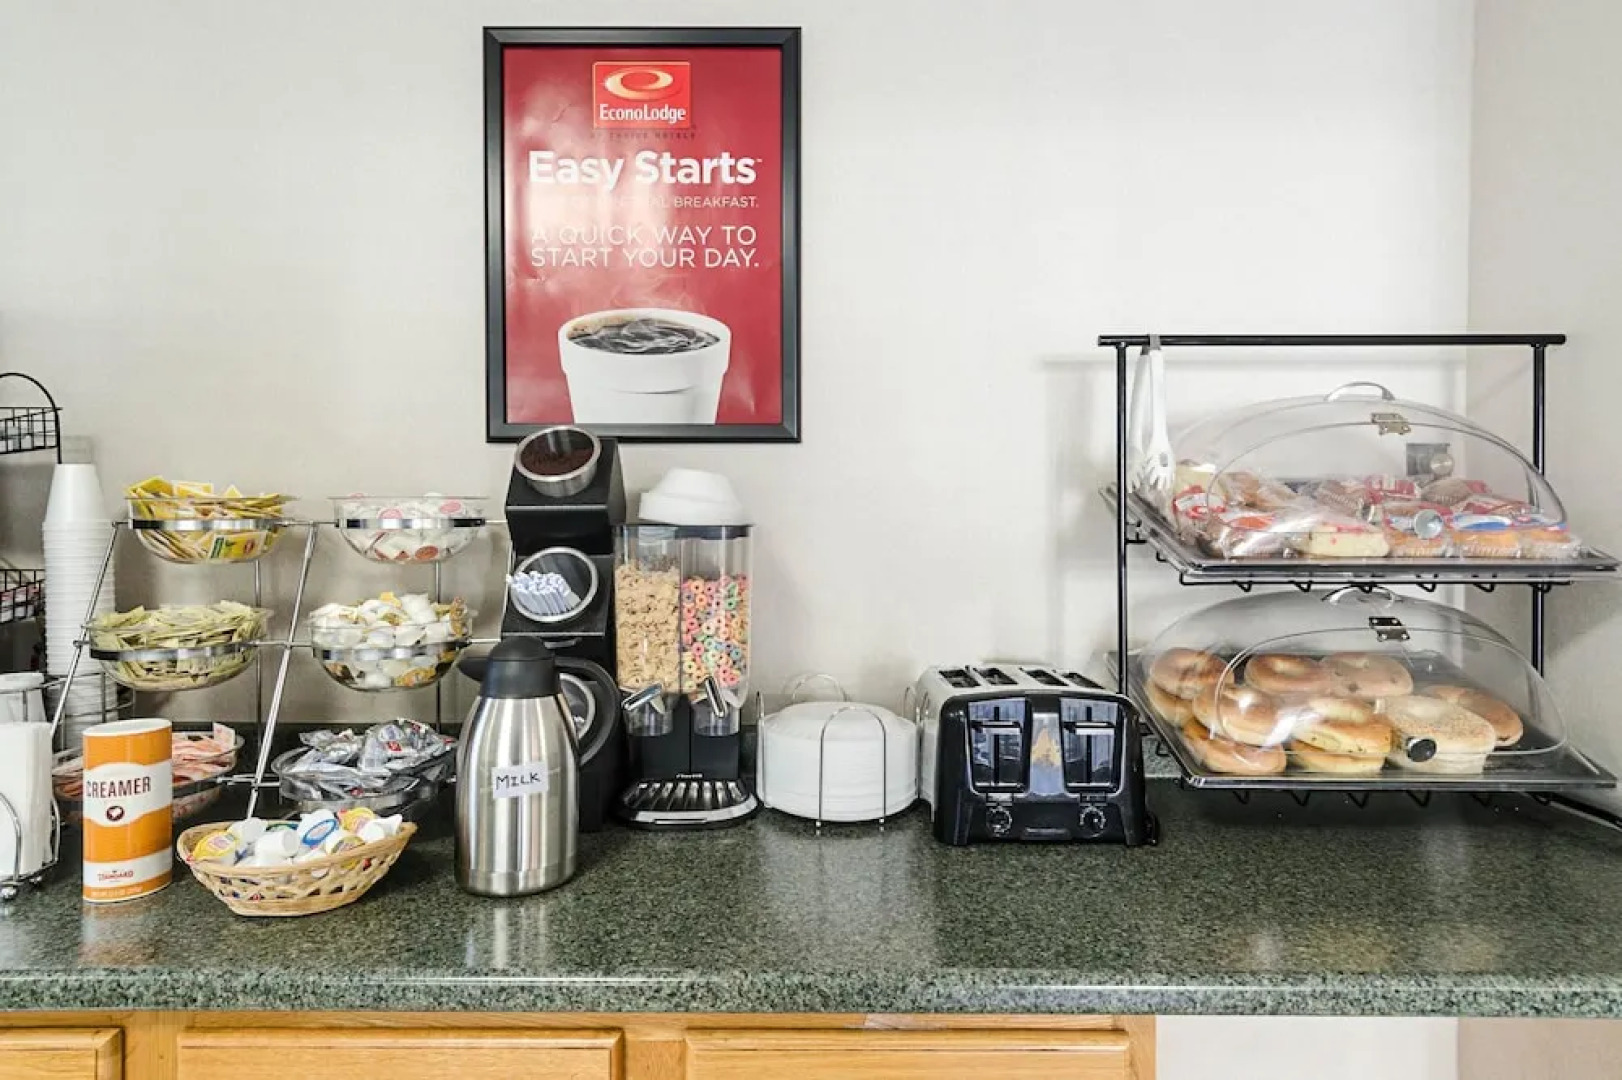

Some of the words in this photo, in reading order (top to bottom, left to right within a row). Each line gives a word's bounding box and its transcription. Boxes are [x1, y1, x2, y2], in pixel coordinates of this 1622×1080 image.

[599, 103, 687, 125] EconoLodge
[528, 150, 624, 191] Easy
[674, 195, 760, 208] BREAKFAST.
[531, 226, 547, 244] A
[559, 226, 644, 246] QUICK
[653, 226, 712, 245] WAY
[721, 226, 757, 245] TO
[531, 247, 614, 267] START
[622, 247, 695, 267] YOUR
[704, 248, 760, 267] DAY.
[86, 776, 151, 799] CREAMER
[495, 771, 542, 790] MILK
